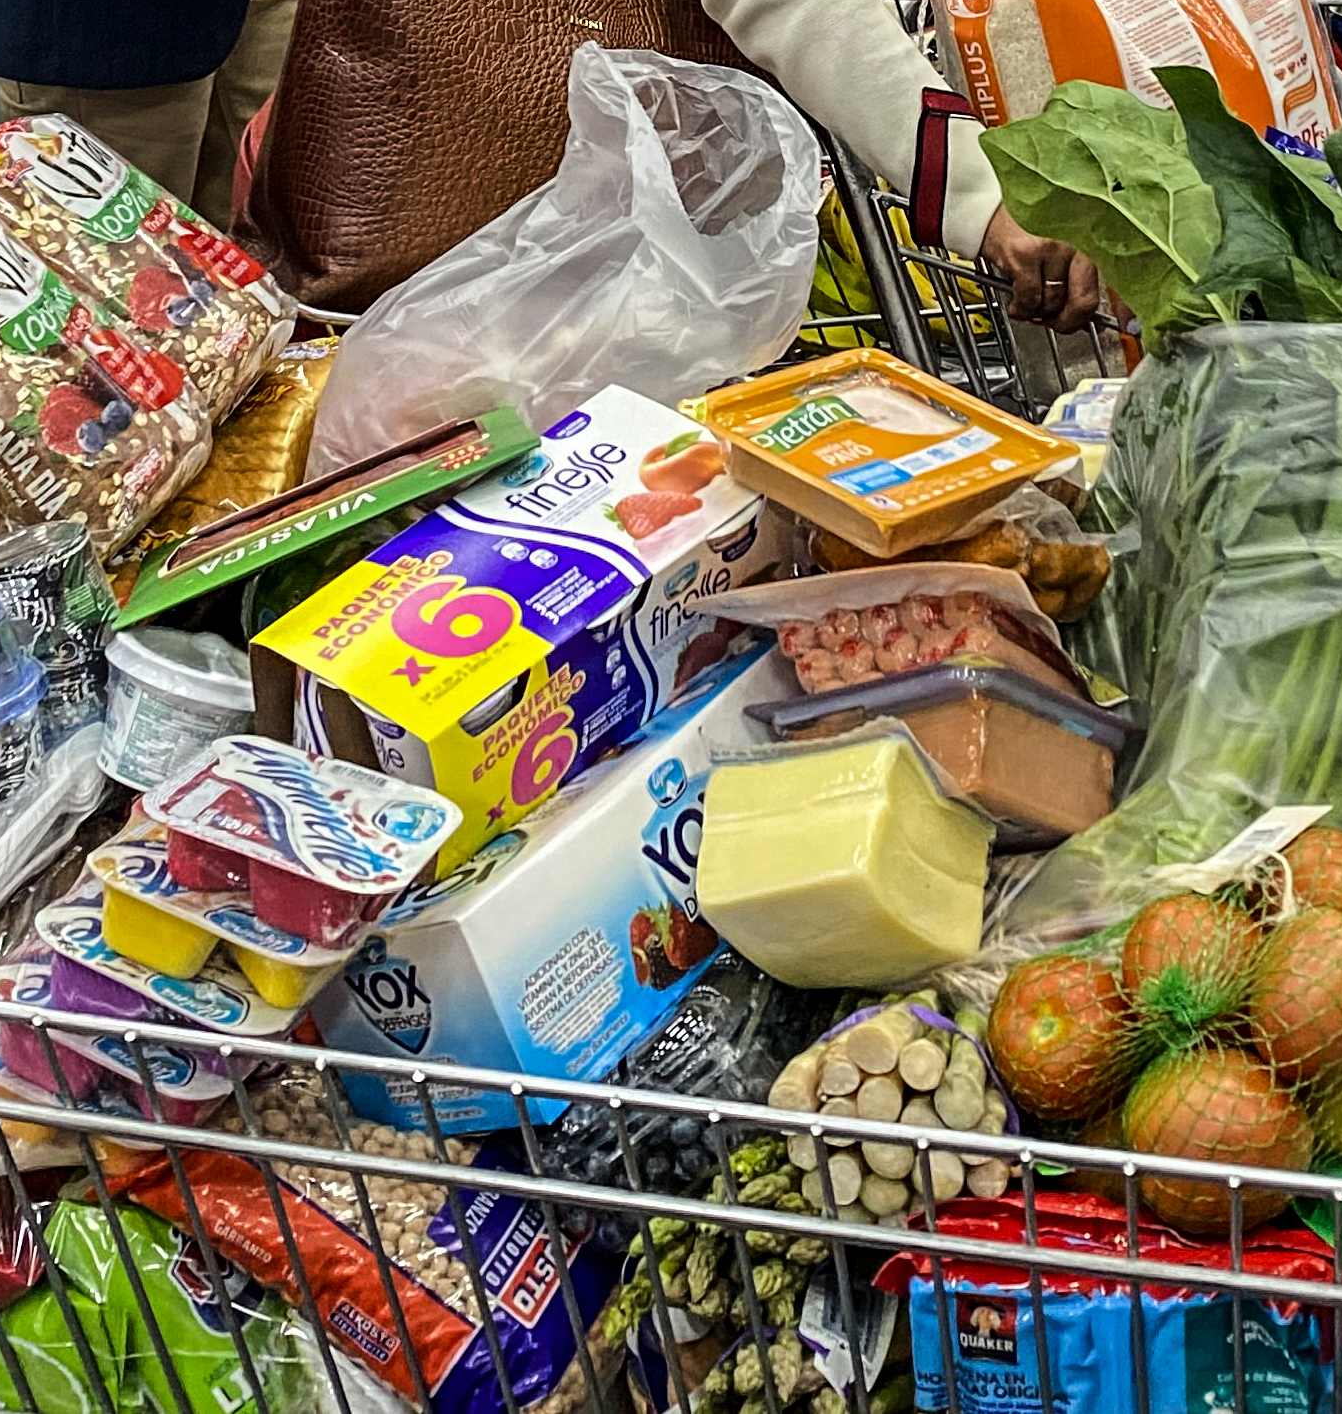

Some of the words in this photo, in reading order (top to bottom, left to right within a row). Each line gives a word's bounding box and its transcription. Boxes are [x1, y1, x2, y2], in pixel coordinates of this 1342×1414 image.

[93, 187, 149, 238] 100%
[753, 397, 851, 455] Pietrán
[819, 442, 875, 467] PAVO
[313, 554, 421, 642] PAQUETE
[318, 549, 455, 662] ECONÓMICO
[391, 577, 517, 659] 6
[470, 669, 587, 786] ECONÓMICO
[480, 661, 573, 753] PAQUETE
[508, 707, 578, 808] 6
[212, 1217, 275, 1265] GARBANZO
[960, 1332, 1014, 1352] QUAKER
